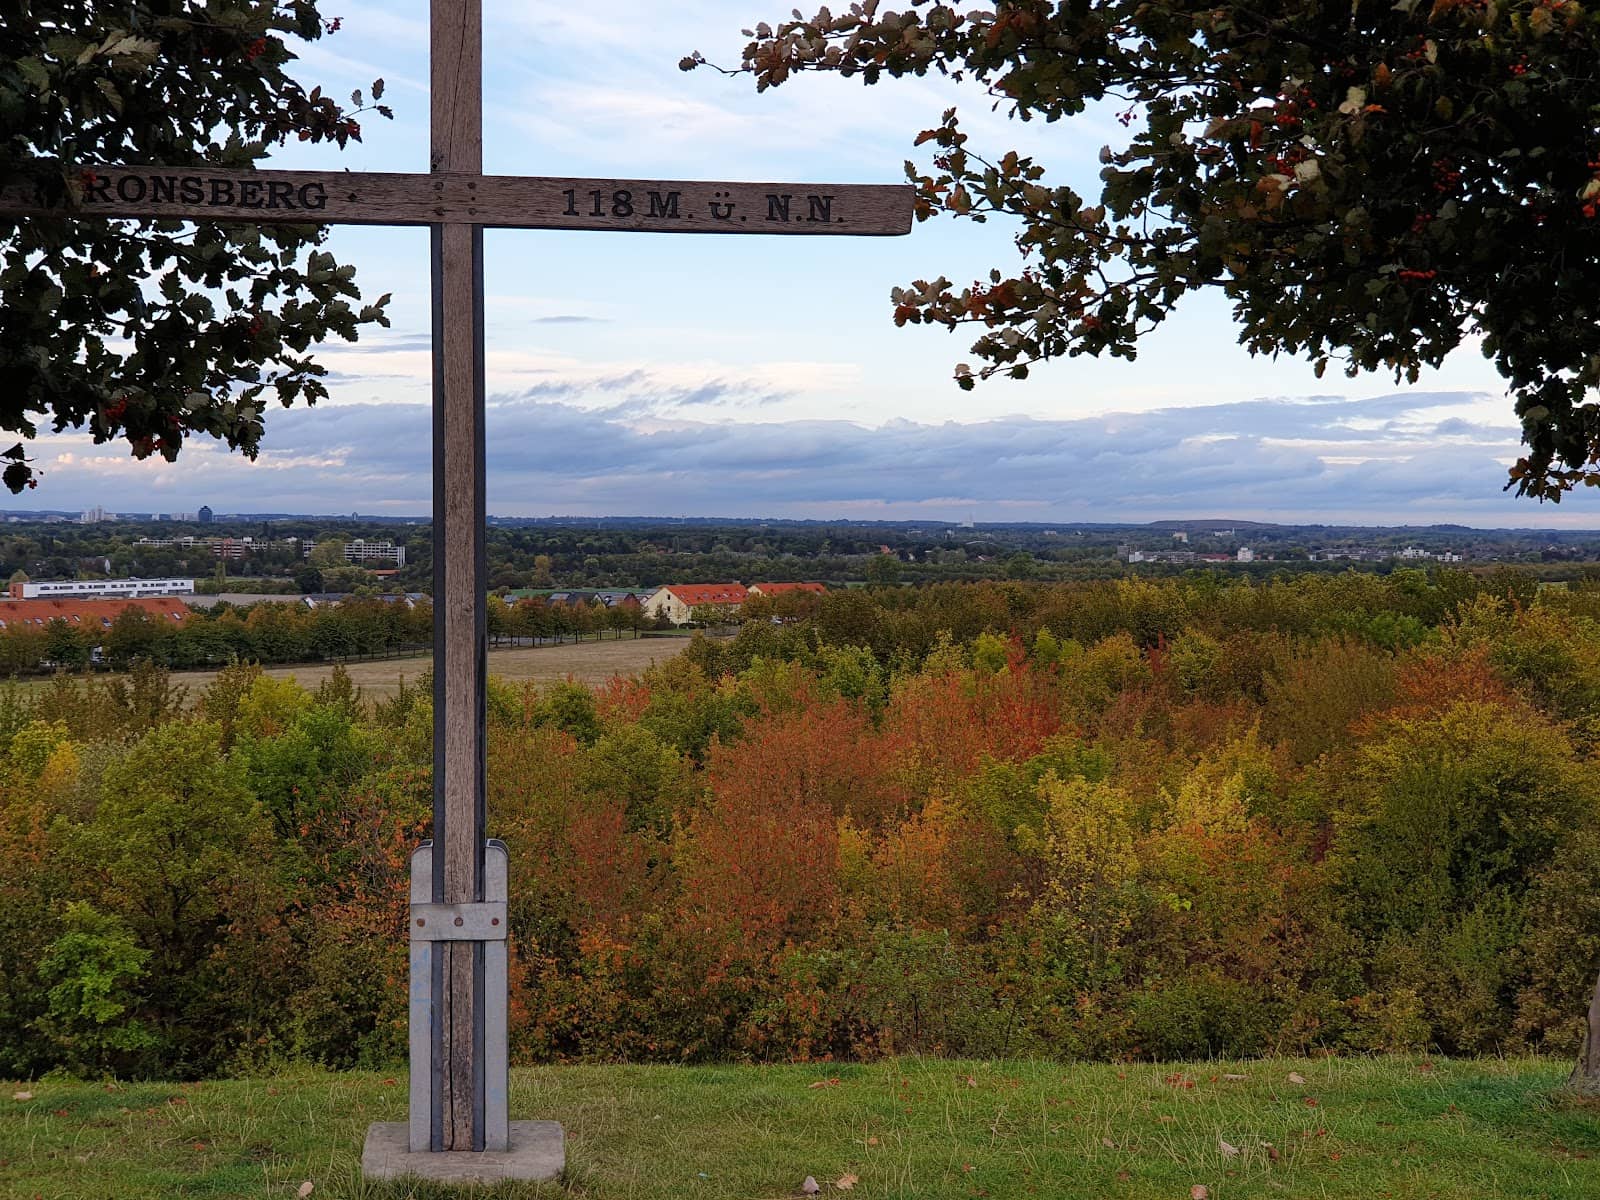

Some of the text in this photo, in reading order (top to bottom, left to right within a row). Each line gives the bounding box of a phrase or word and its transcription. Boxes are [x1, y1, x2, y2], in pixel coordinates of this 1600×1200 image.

[76, 174, 328, 210] RONSBERG
[562, 188, 634, 218] 118
[765, 194, 845, 223] N.N.
